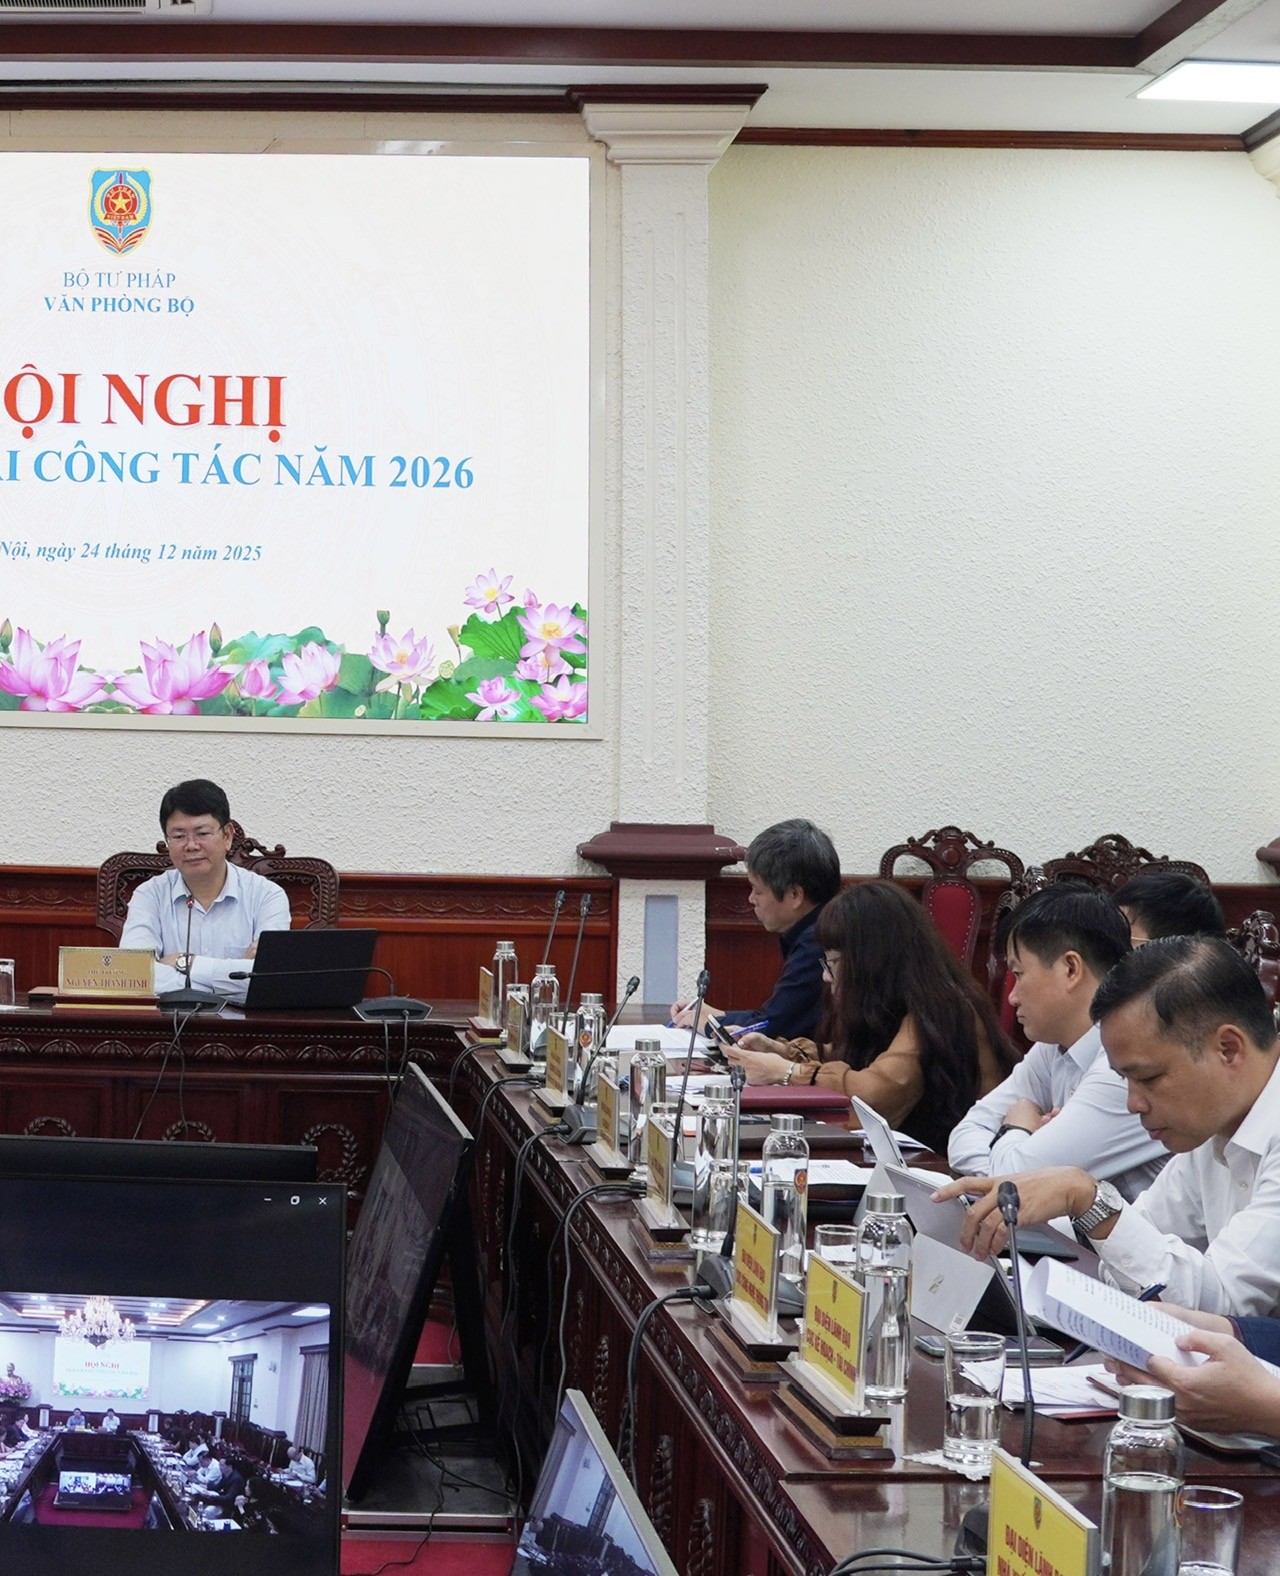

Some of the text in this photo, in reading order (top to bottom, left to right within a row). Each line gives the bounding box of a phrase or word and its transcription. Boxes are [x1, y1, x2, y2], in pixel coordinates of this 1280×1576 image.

[63, 268, 176, 290] BỘ TƯ PHÁP
[44, 293, 195, 317] VĂN PHÒNG BỘ
[101, 374, 287, 443] NGHỊ
[33, 440, 161, 483] CÔNG
[173, 443, 262, 486] TÁC
[273, 445, 377, 488] NĂM
[389, 455, 474, 489] 2026
[36, 543, 76, 562] ngày
[81, 543, 100, 558] 24
[105, 542, 151, 564] tháng
[158, 544, 176, 560] 12
[181, 545, 217, 561] năm
[222, 545, 262, 561] 2025
